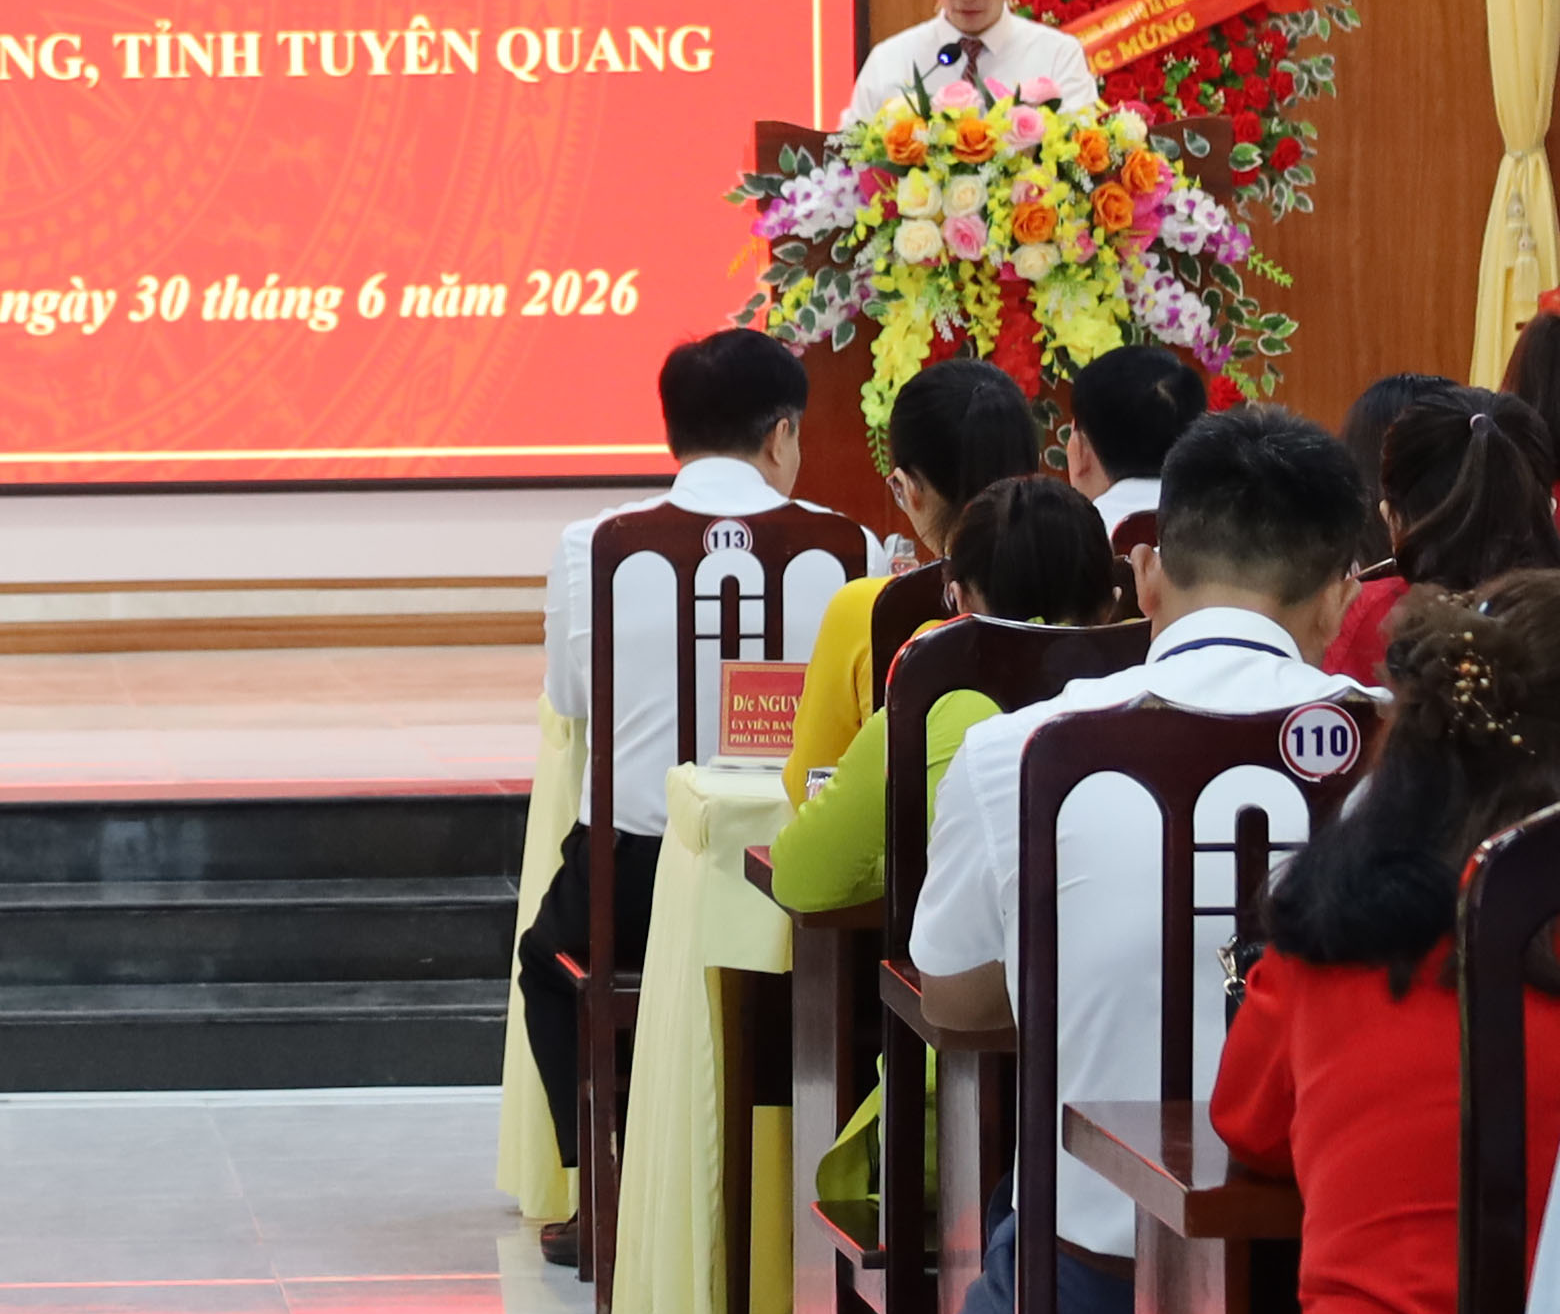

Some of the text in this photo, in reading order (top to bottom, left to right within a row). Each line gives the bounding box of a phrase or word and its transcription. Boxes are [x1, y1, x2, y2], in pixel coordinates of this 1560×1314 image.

[113, 20, 262, 78] TỈNH
[277, 15, 480, 76] TUYÊN
[497, 26, 713, 82] QUANG
[128, 275, 190, 322] 30
[202, 274, 344, 332] tháng
[358, 273, 386, 318] 6
[400, 273, 507, 318] năm
[521, 269, 638, 315] 2026
[711, 530, 745, 549] 113
[758, 694, 801, 713] NGUY
[1291, 725, 1348, 757] 110
